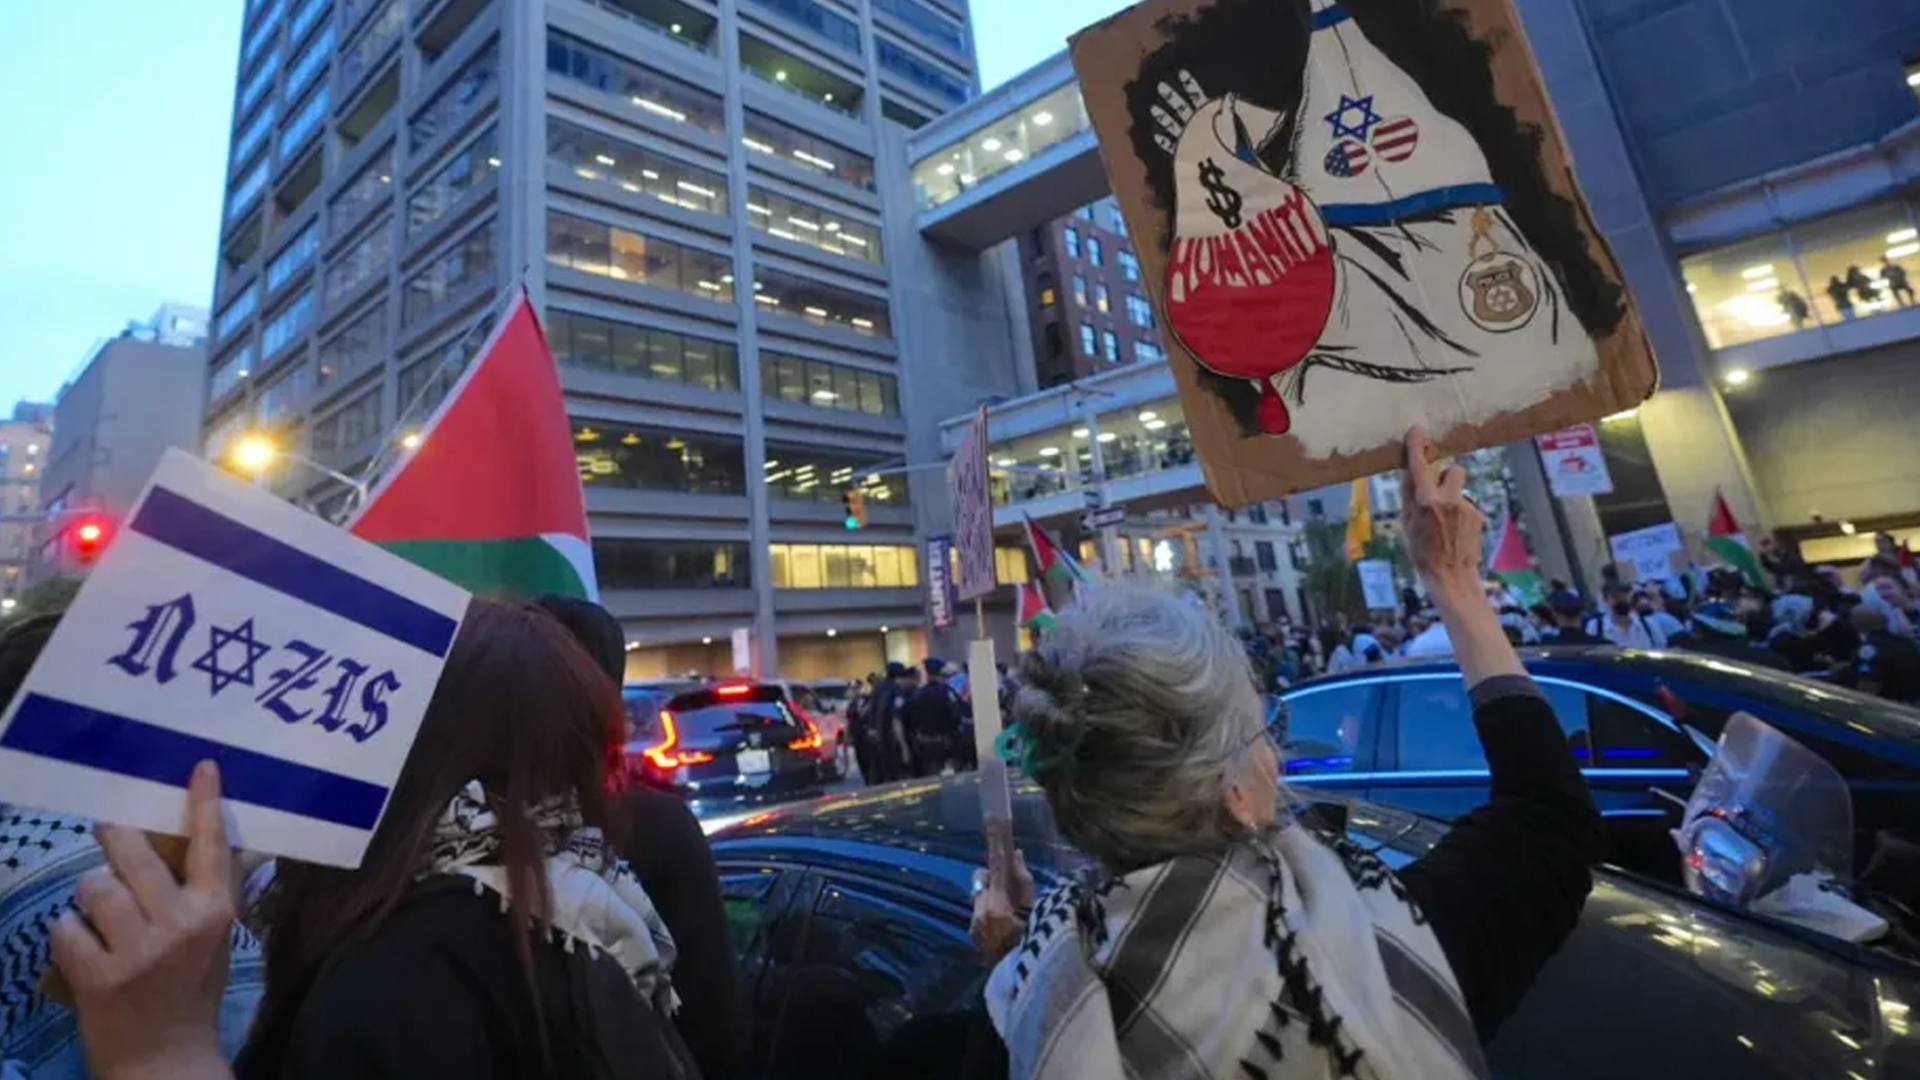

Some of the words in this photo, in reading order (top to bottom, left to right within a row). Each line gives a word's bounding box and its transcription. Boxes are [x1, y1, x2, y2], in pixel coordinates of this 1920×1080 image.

[1170, 184, 1322, 303] HUMANITY
[927, 540, 949, 627] HUNTER
[105, 592, 401, 742] NZIS
